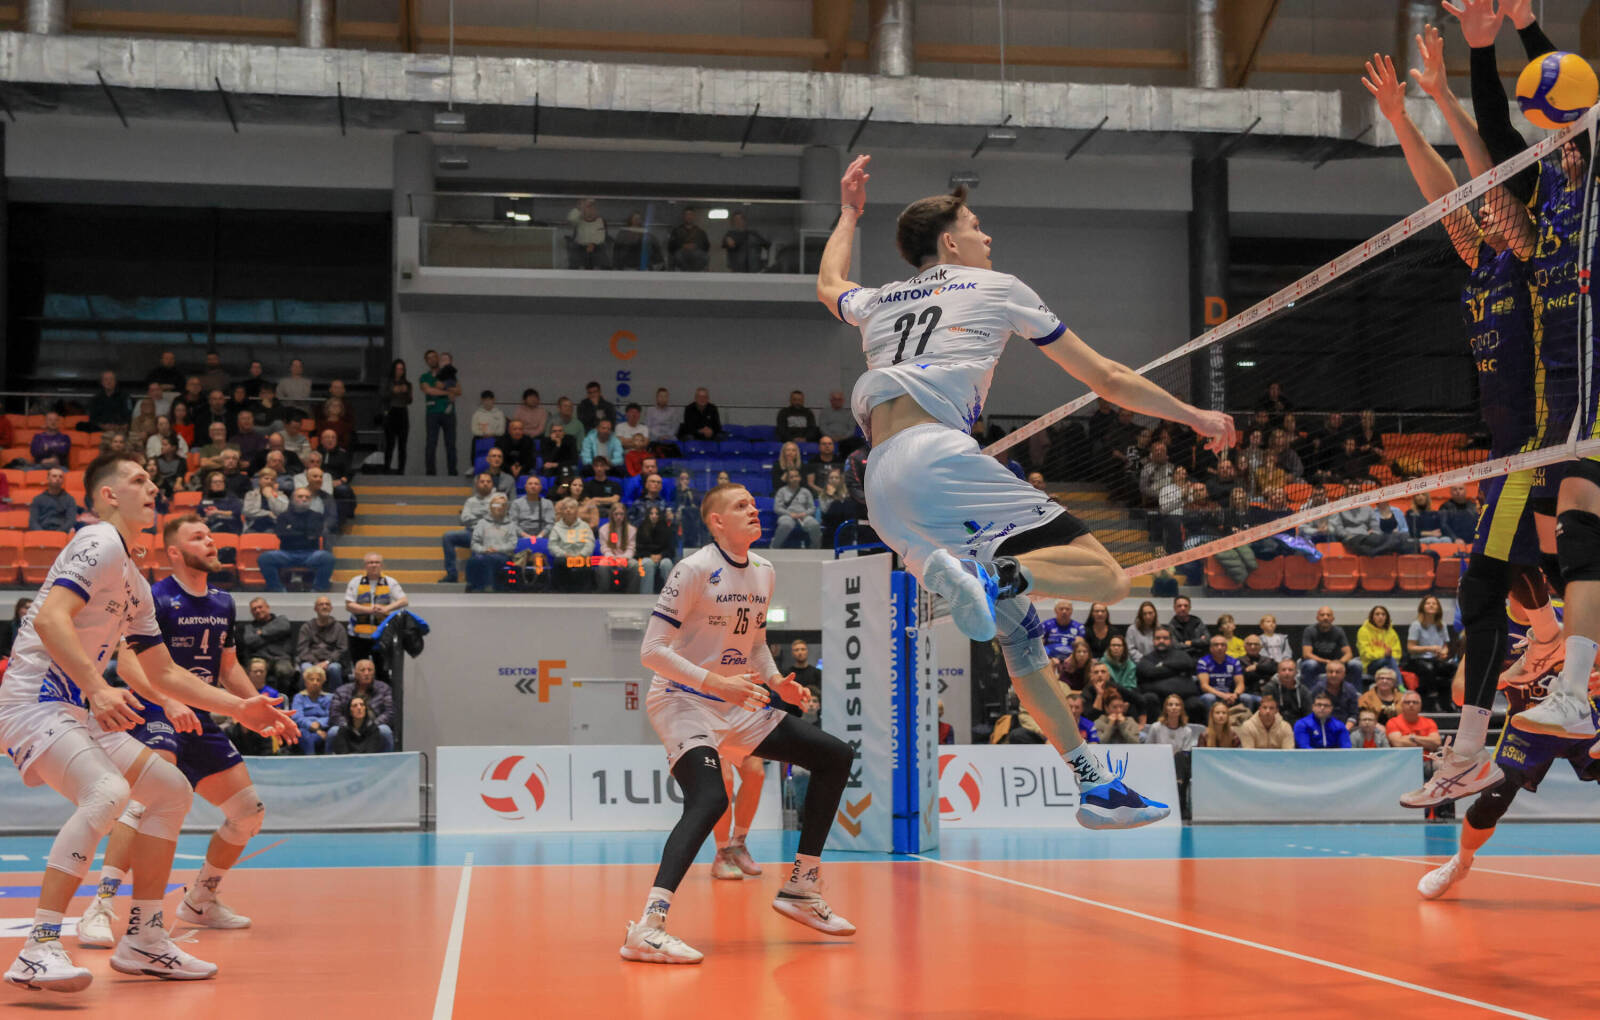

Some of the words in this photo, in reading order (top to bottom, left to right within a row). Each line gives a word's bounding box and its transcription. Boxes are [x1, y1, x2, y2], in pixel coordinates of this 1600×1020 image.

[1204, 296, 1228, 325] D
[608, 329, 639, 361] C
[716, 593, 748, 604] KARTON
[178, 615, 210, 625] KARTON
[733, 607, 750, 635] 25
[200, 628, 211, 655] 4
[498, 667, 538, 677] SEKTOR
[538, 660, 567, 703] F
[846, 575, 863, 789] KRISHOME
[938, 668, 965, 677] KTOR
[1000, 766, 1082, 808] PL
